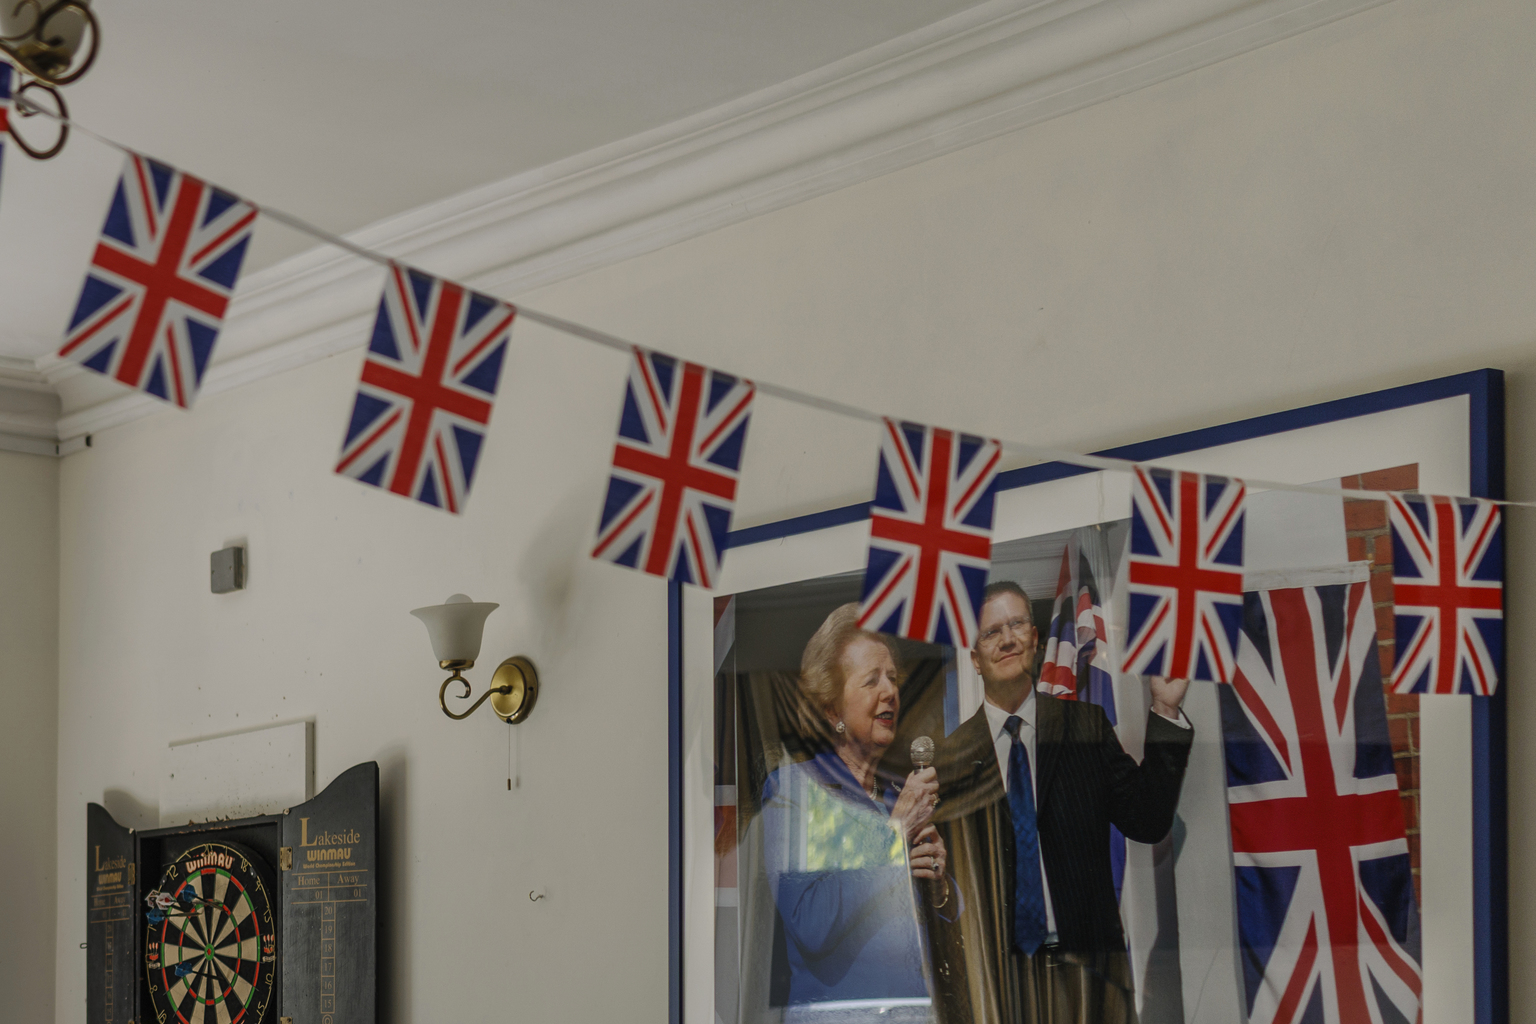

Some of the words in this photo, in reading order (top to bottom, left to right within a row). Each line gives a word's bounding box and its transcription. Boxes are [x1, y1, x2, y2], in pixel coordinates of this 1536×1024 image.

[299, 817, 361, 847] Lakeside
[306, 848, 352, 861] WINMAU
[298, 875, 321, 886] Home
[337, 874, 360, 885] Away
[324, 906, 333, 915] 20
[324, 925, 333, 934] 19
[324, 944, 333, 953] 18
[324, 962, 333, 971] 17
[324, 981, 333, 990] 16
[324, 1000, 333, 1009] 15
